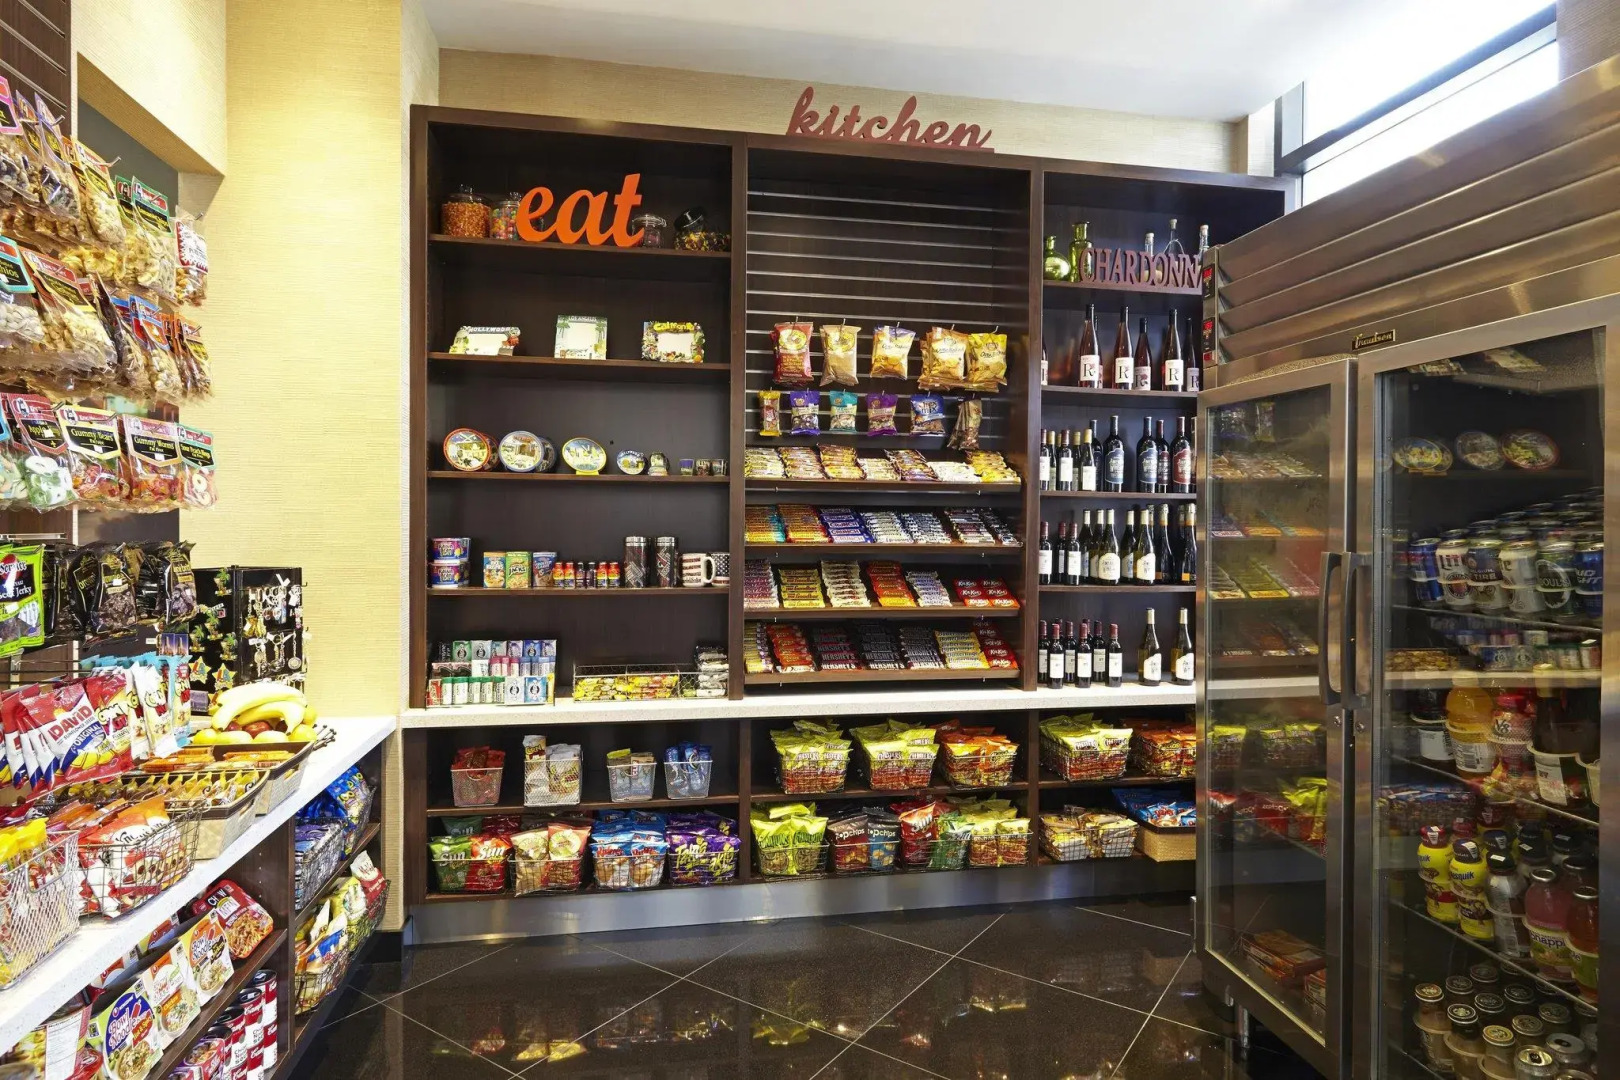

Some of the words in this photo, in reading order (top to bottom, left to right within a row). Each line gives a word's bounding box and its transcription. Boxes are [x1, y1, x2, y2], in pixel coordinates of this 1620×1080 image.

[786, 86, 993, 149] kitchen
[516, 173, 645, 247] eat
[71, 428, 98, 441] Gummy
[133, 436, 157, 446] Gummy
[48, 705, 93, 741] DAVID
[1495, 719, 1511, 734] V8
[479, 844, 505, 861] Sun
[207, 888, 228, 906] CHW
